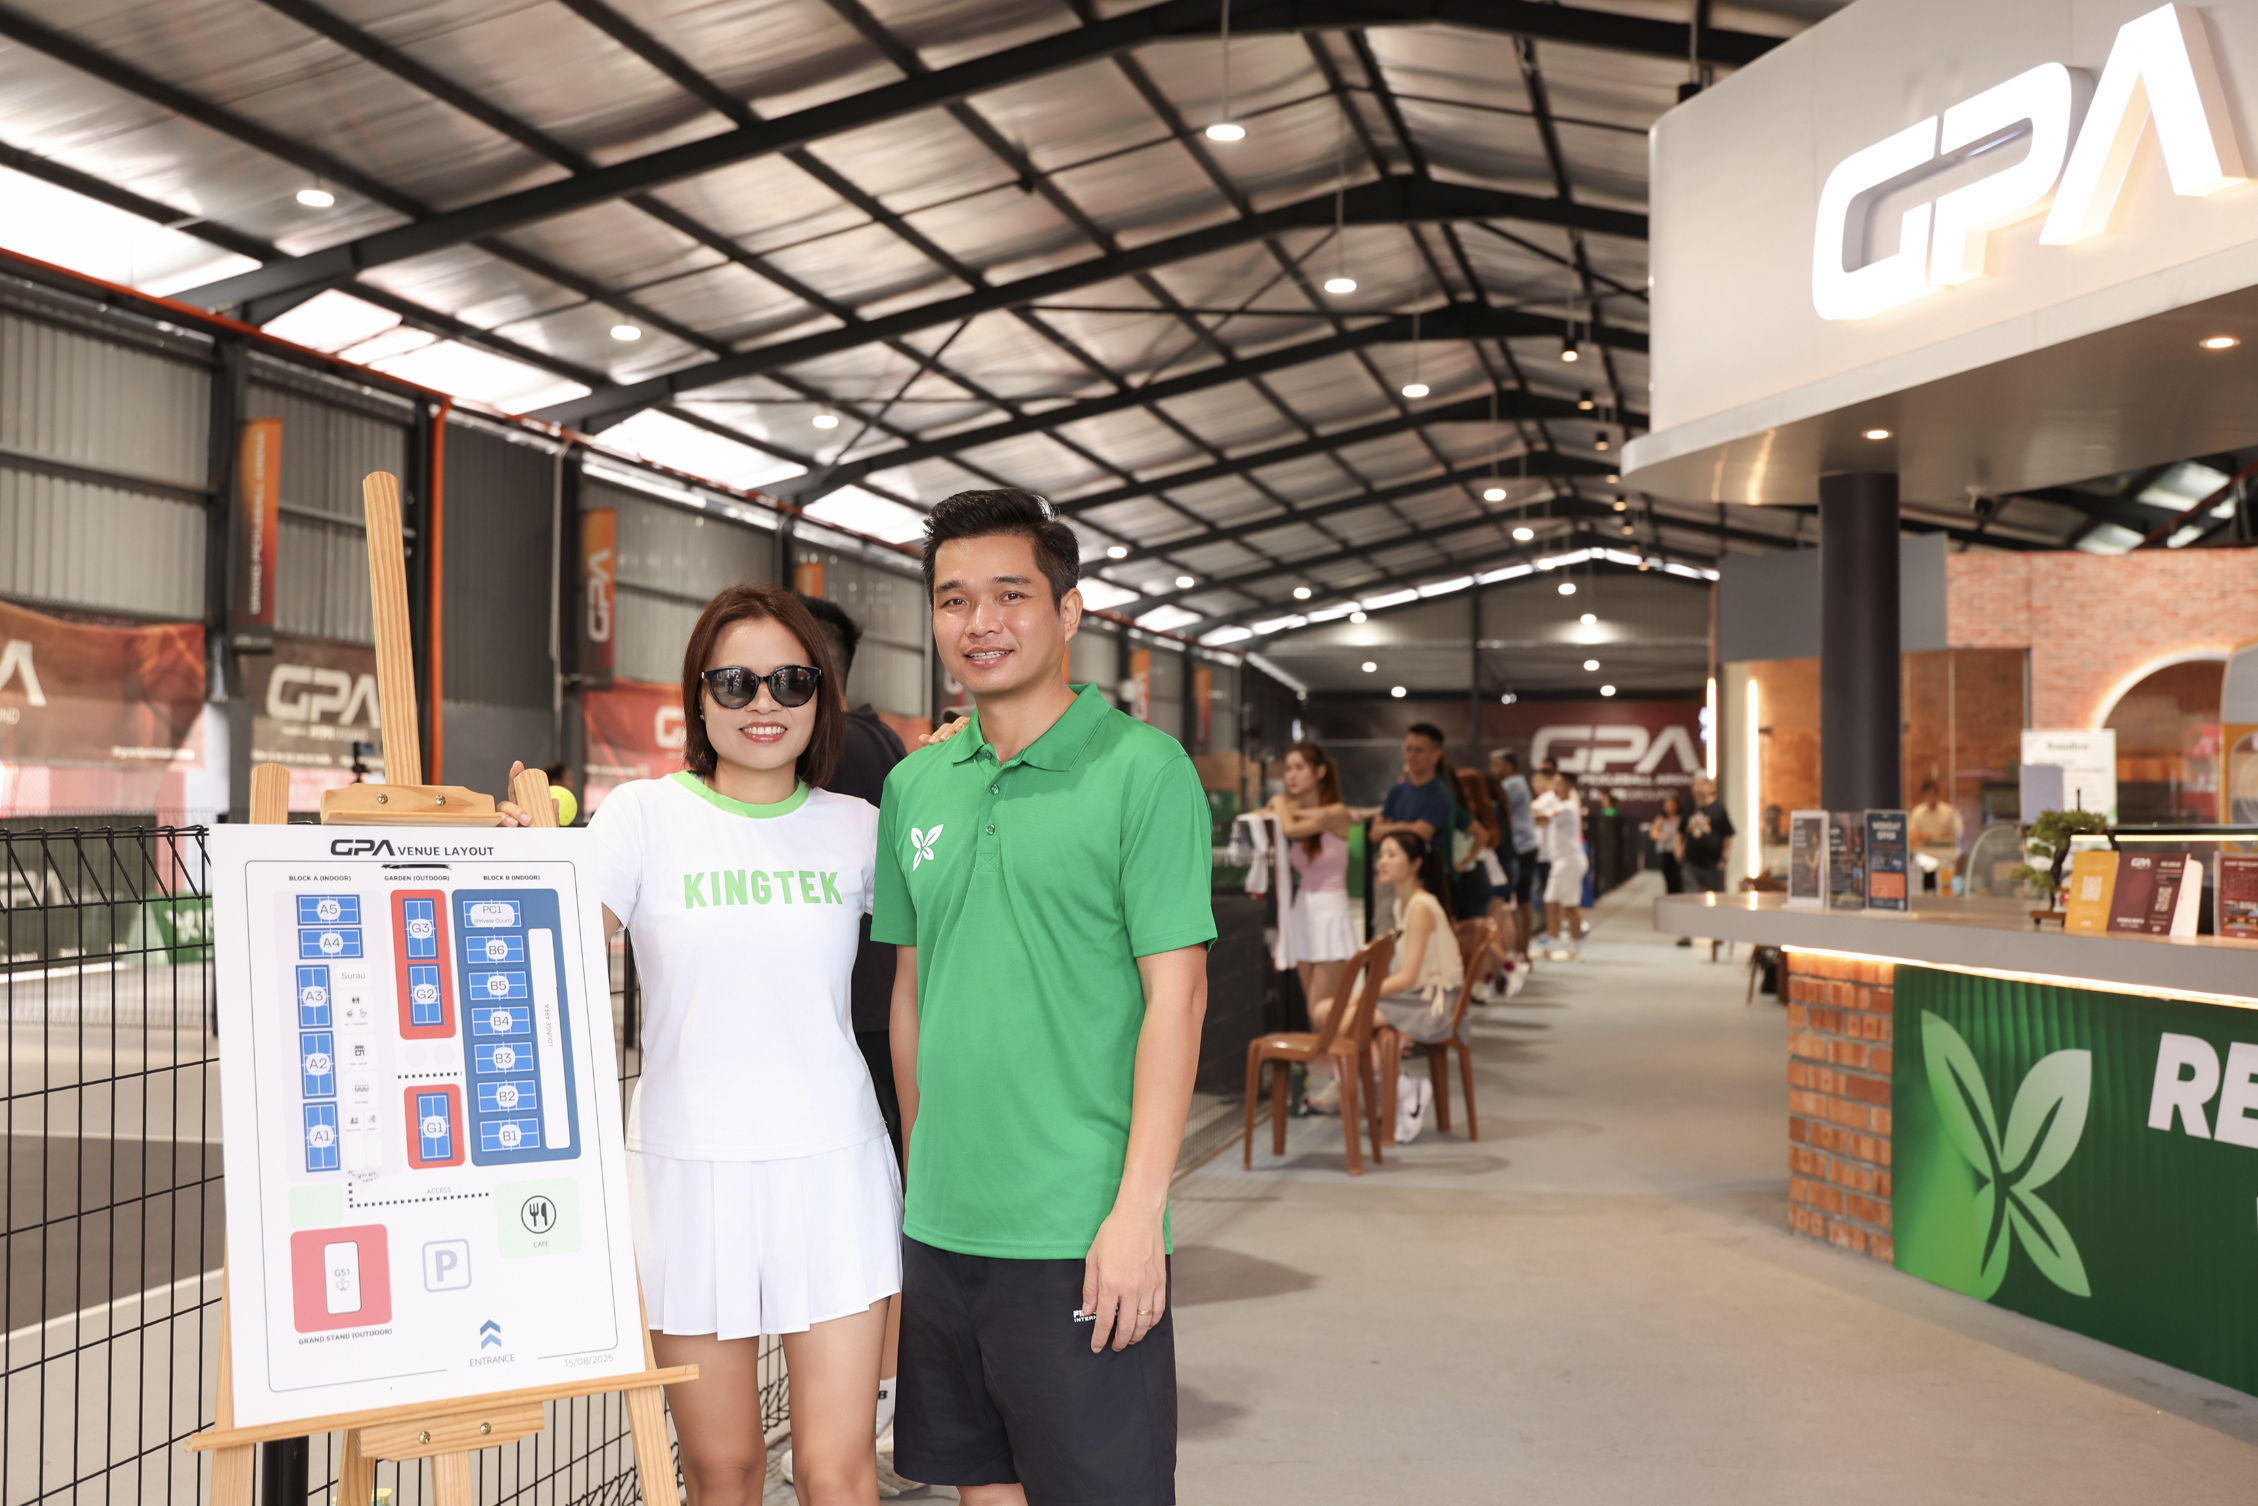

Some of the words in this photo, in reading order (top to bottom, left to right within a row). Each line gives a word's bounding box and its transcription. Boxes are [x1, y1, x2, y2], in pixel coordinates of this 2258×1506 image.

[1812, 2, 2236, 321] GPA
[266, 663, 381, 729] GPA
[1530, 725, 1700, 773] GPA
[331, 839, 396, 856] GPA
[398, 846, 440, 856] VENUE
[445, 846, 494, 856] LAYOUT
[683, 869, 843, 910] KINGTEK
[320, 904, 338, 915] A5
[482, 905, 502, 914] PC1
[411, 923, 430, 933] G3
[323, 938, 340, 948] A4
[488, 945, 505, 955] B6
[341, 972, 366, 980] Surau
[490, 981, 507, 991] B5
[305, 990, 324, 1001] A3
[416, 989, 435, 999] G2
[493, 1016, 510, 1026] B4
[545, 1021, 553, 1047] LOUNGE
[309, 1058, 327, 1069] A2
[495, 1053, 512, 1064] B3
[499, 1090, 516, 1102] B2
[426, 1122, 444, 1133] G1
[314, 1130, 330, 1142] A1
[502, 1130, 518, 1141] B1
[426, 1186, 452, 1194] ACCESS
[533, 1240, 549, 1248] CAFE
[334, 1268, 350, 1277] GS1
[298, 1335, 325, 1345] GRAND
[326, 1333, 351, 1342] STAND
[352, 1328, 393, 1339] (OUTDOOR)
[469, 1353, 515, 1367] ENTRANCE
[565, 1354, 614, 1367] 15/08/2025
